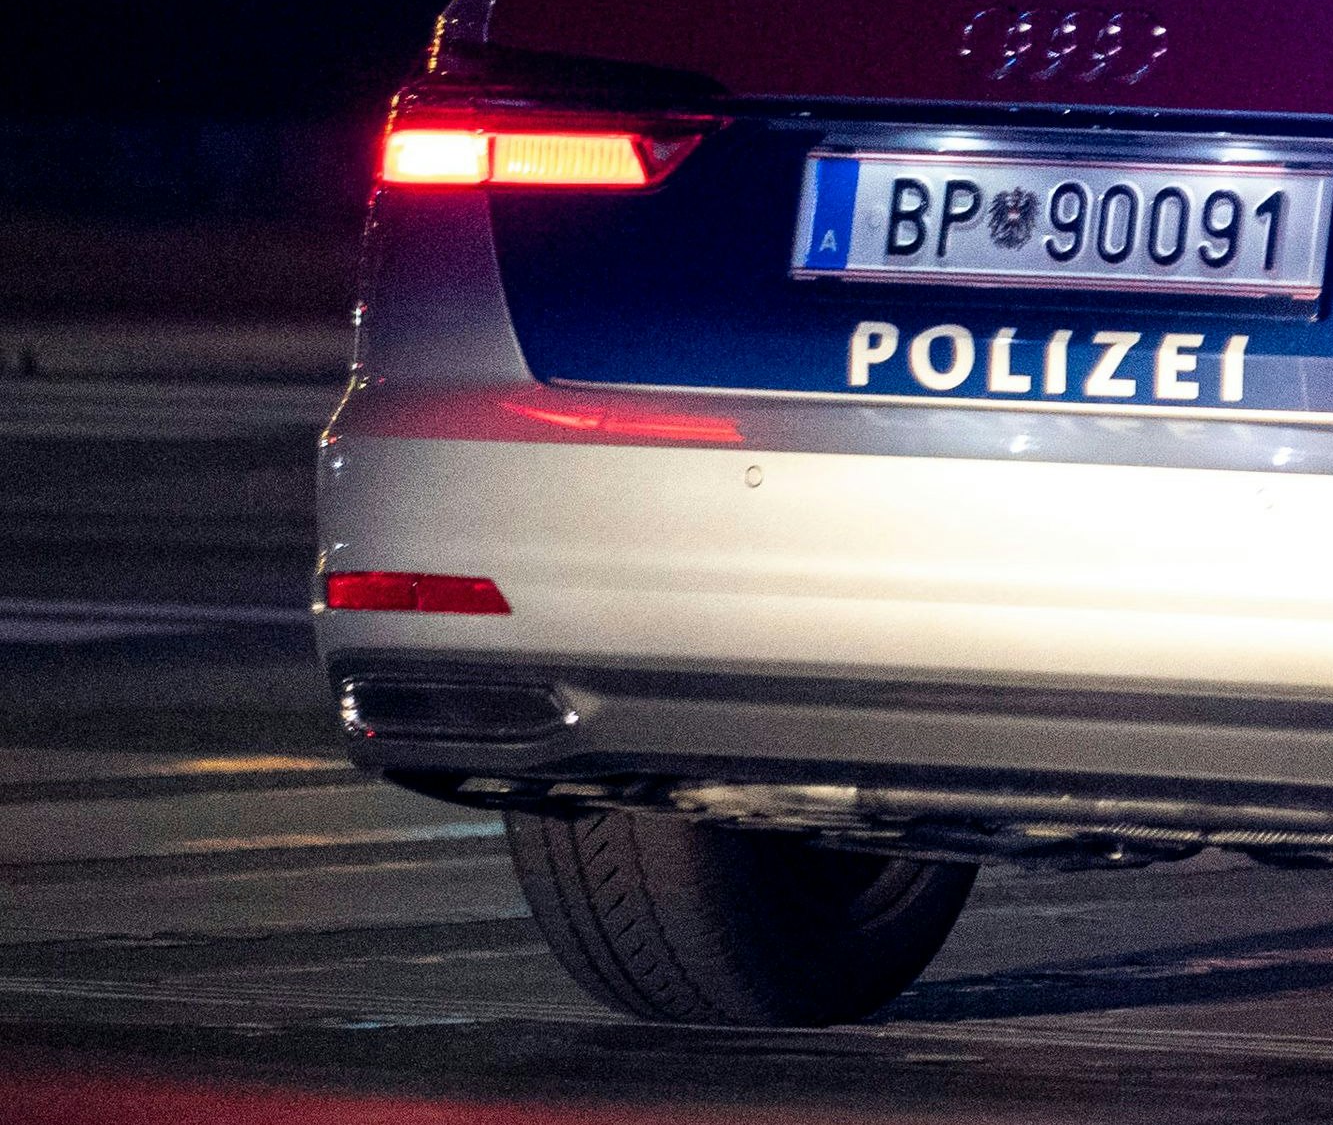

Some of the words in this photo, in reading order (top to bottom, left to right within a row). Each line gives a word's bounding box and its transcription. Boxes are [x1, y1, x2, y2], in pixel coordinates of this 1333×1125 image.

[818, 228, 838, 253] A
[885, 177, 983, 258] BP
[1044, 181, 1286, 271] 90091
[847, 320, 1249, 402] POLIZEI
